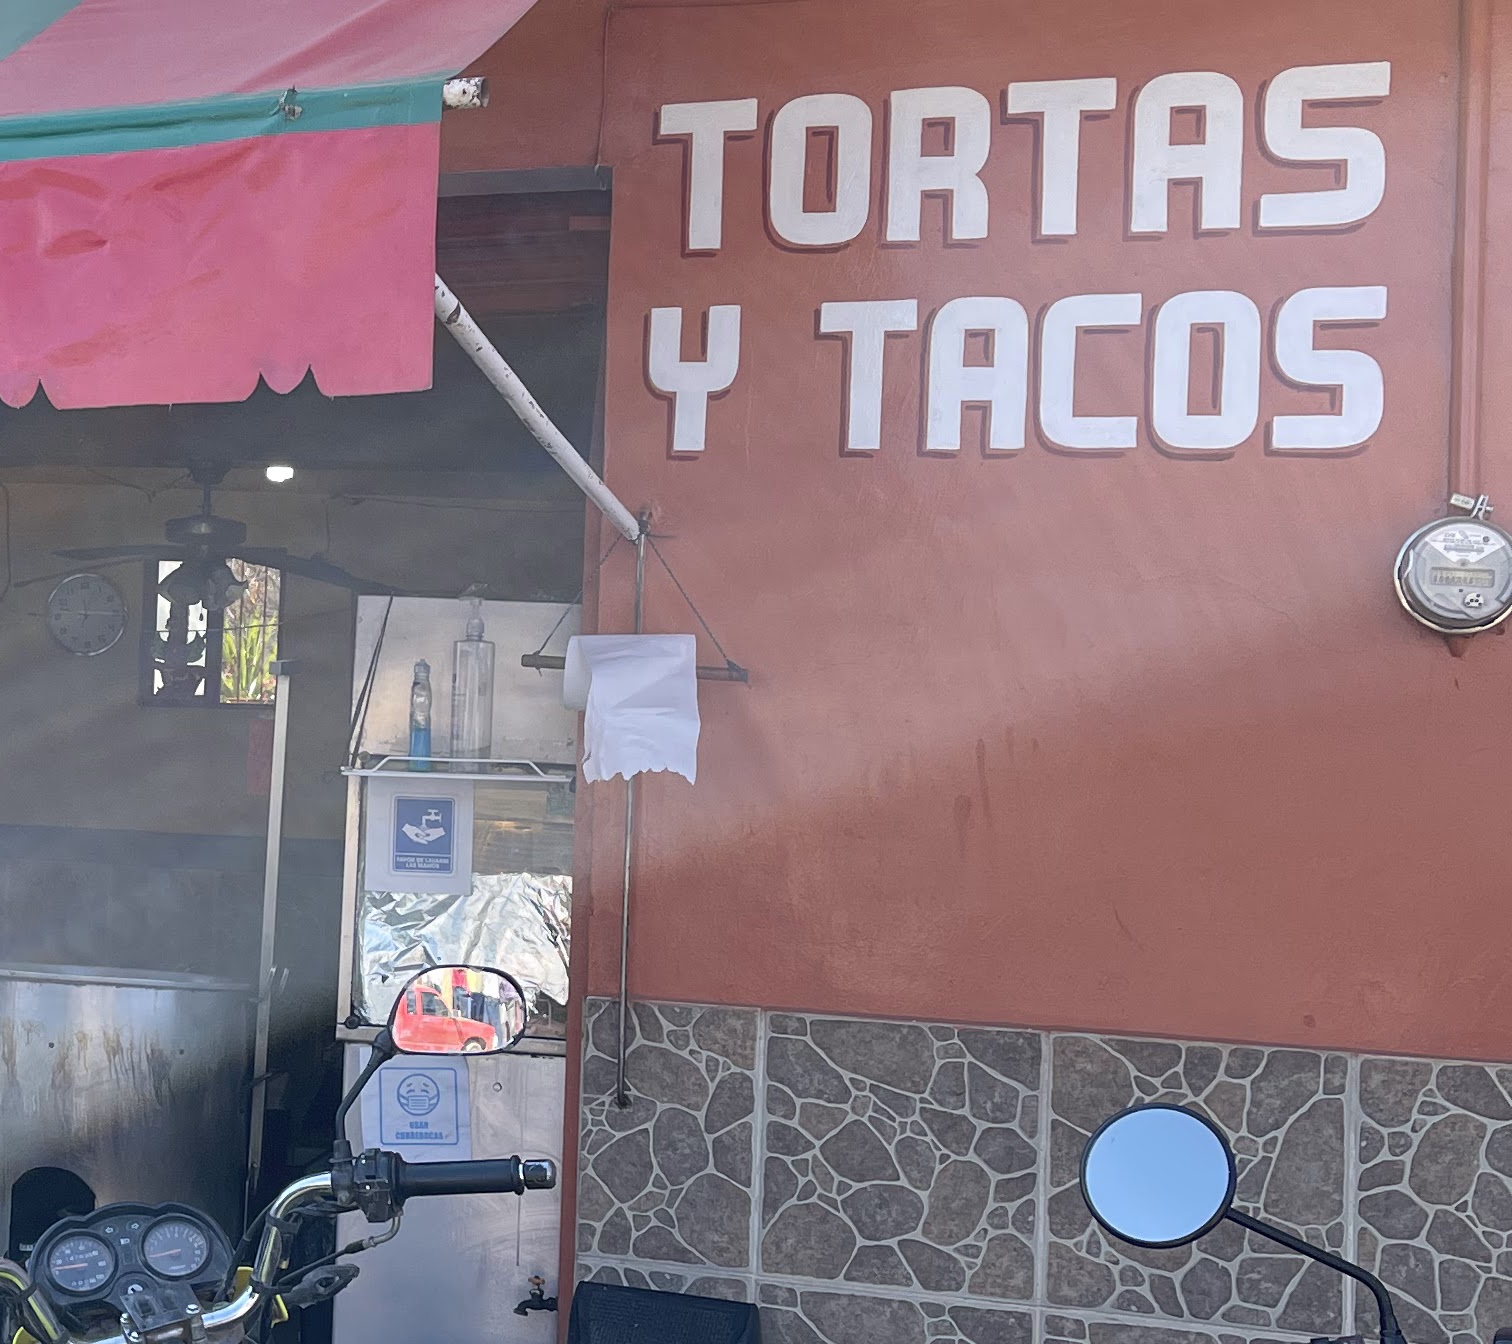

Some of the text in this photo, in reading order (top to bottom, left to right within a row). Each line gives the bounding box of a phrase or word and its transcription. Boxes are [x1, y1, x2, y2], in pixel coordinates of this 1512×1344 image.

[656, 60, 1392, 254] TORTAS
[646, 285, 1389, 454] Y TACOS
